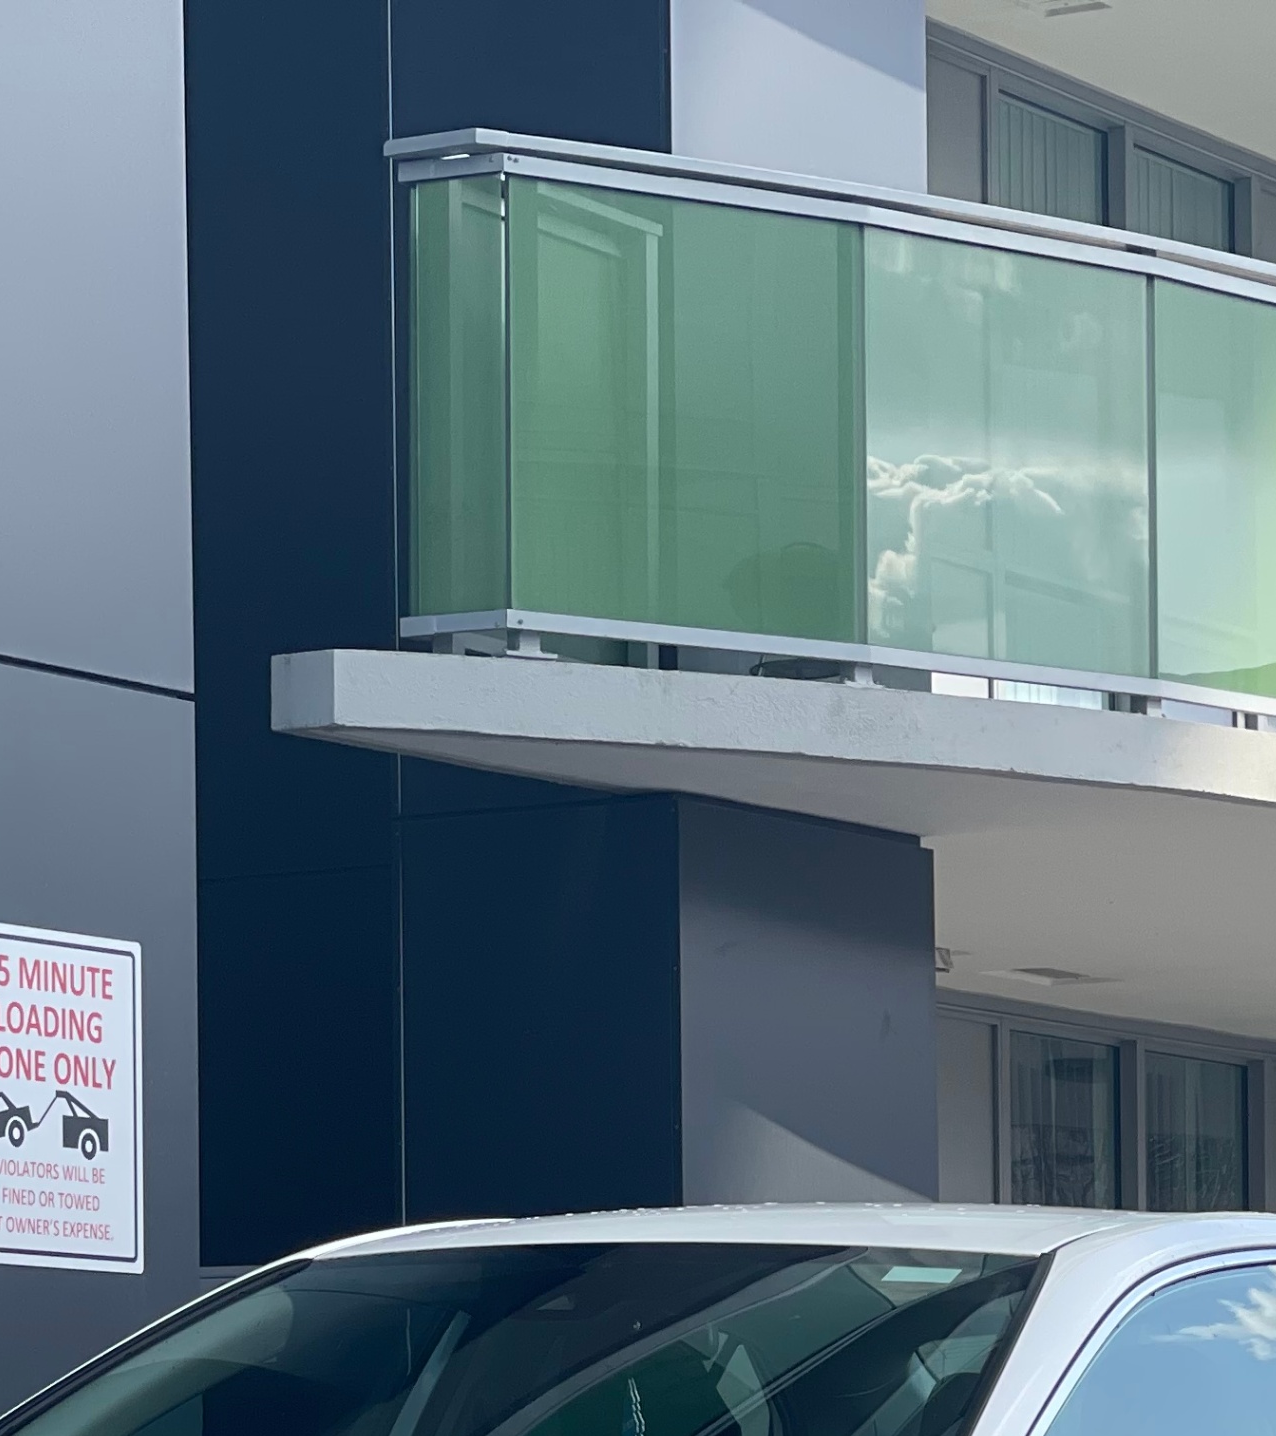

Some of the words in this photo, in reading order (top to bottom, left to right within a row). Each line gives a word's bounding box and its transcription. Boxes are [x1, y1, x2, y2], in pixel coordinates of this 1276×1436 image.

[18, 957, 113, 1000] MINUTE
[53, 1051, 116, 1090] ONLY
[62, 1164, 90, 1183] WILL
[91, 1167, 106, 1185] BE
[1, 1187, 36, 1206] FINED
[38, 1190, 55, 1208] OR
[57, 1192, 101, 1212] TOWED
[5, 1216, 60, 1237] OWNER'S
[62, 1220, 114, 1241] EXPENSE.
